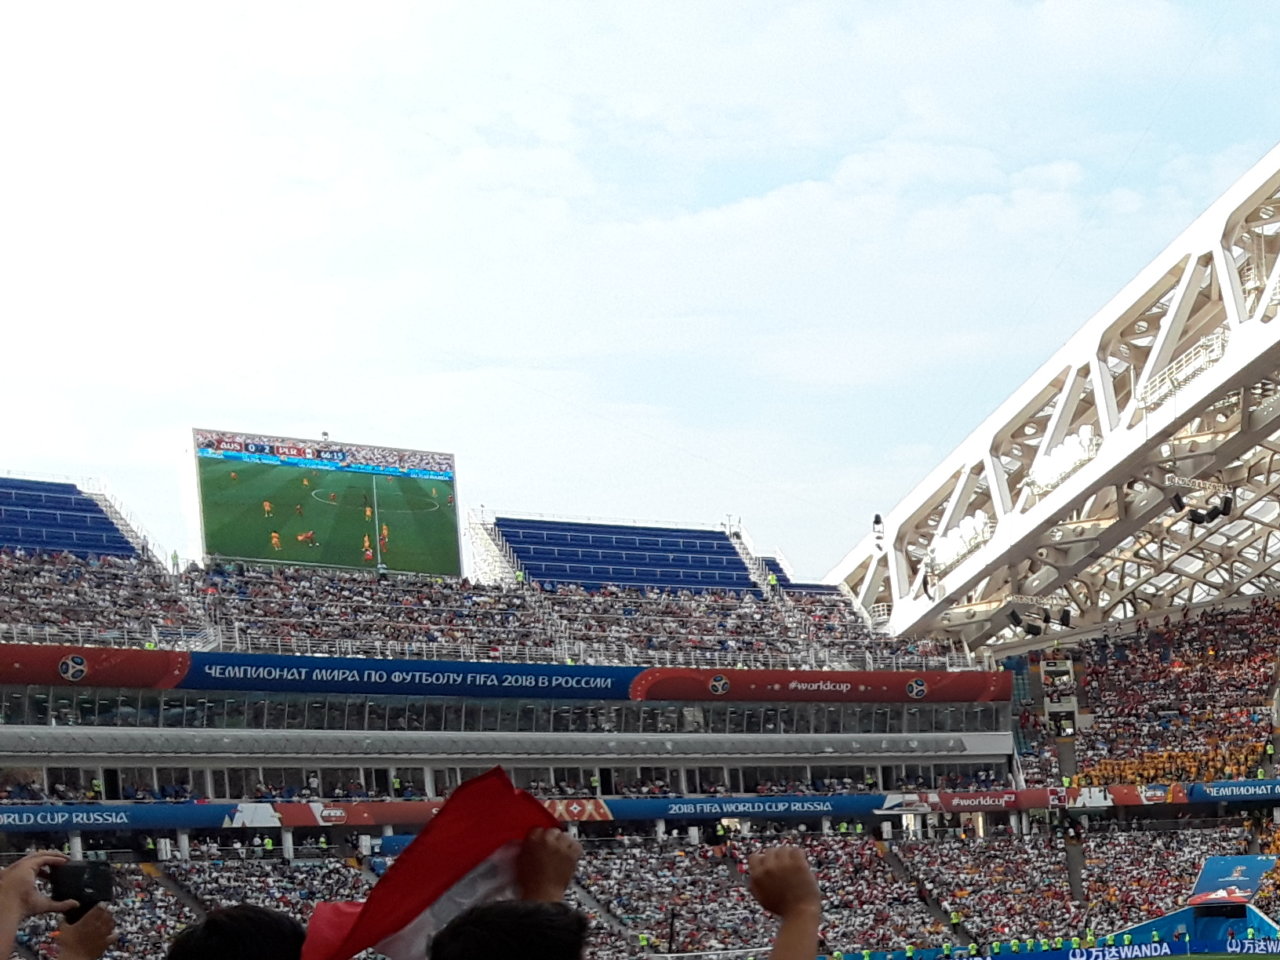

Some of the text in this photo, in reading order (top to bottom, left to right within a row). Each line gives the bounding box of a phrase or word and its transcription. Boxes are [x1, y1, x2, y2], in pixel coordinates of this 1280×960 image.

[204, 665, 612, 688] ЧЕМПИОНАТ МИРА ПО ФУТБОЛУ FIFA 2018 В РОССИИ
[788, 679, 851, 693] #worldcup
[668, 801, 832, 814] 2018 FIFA WORLD CUP RUSSIA
[37, 812, 69, 824] CUP
[72, 812, 128, 824] RUSSIA
